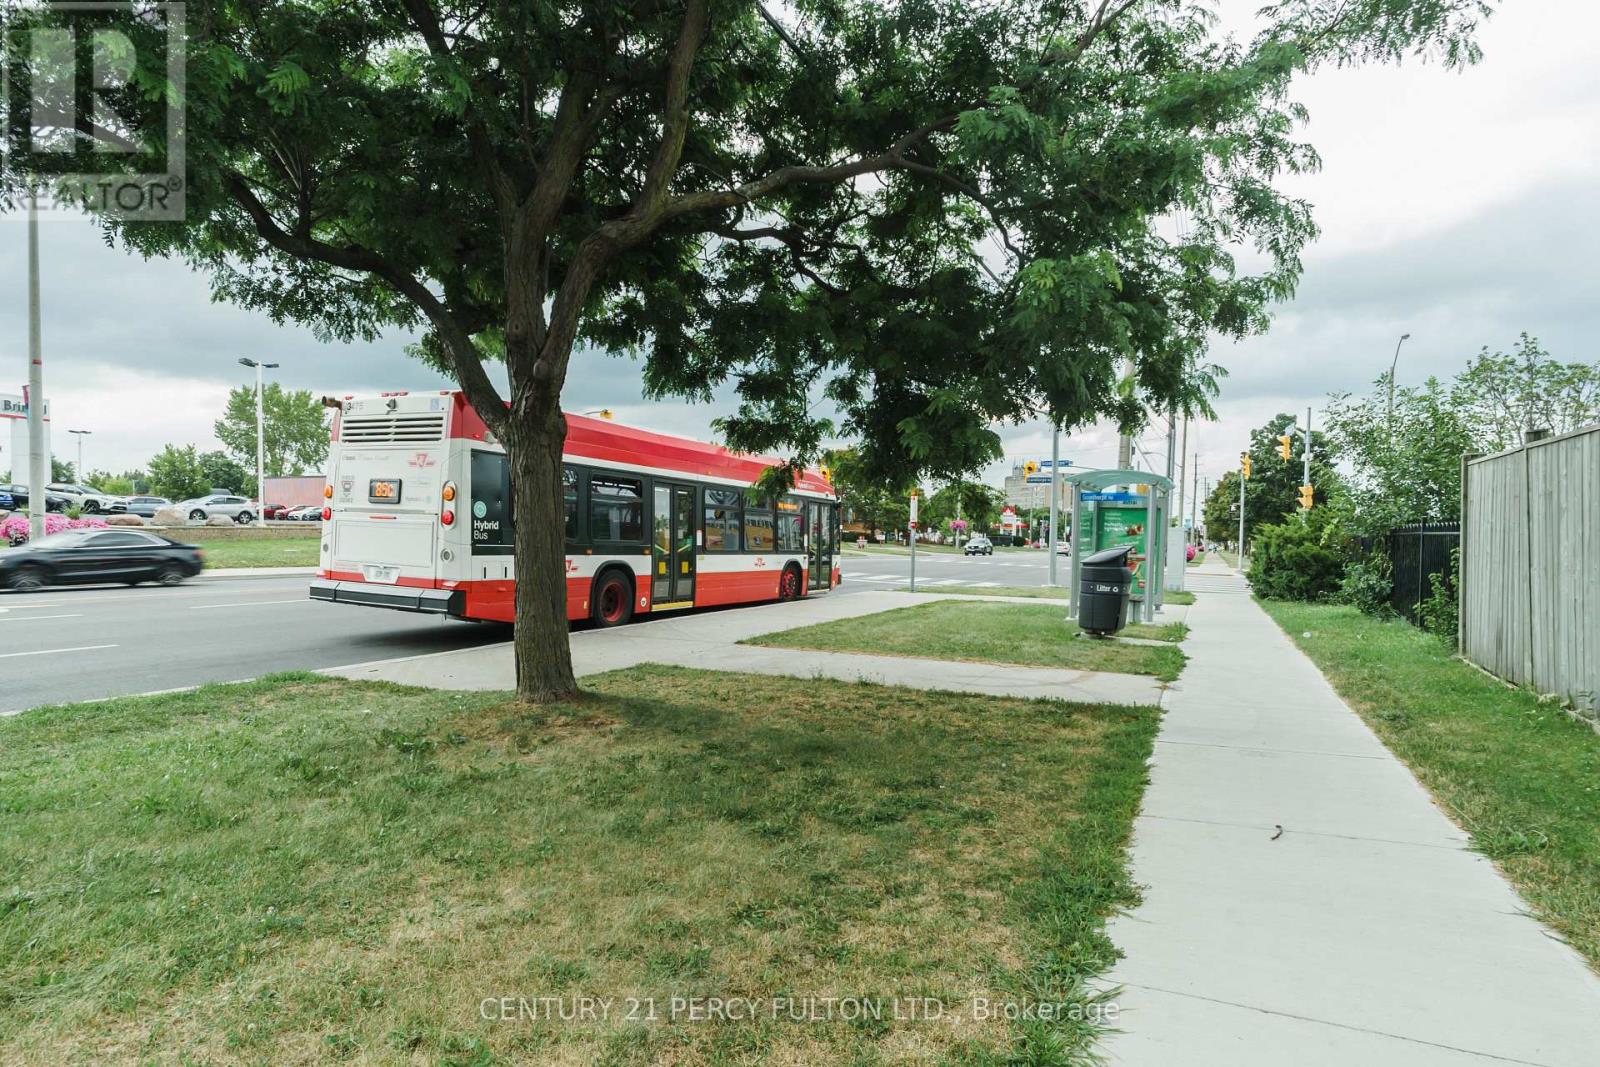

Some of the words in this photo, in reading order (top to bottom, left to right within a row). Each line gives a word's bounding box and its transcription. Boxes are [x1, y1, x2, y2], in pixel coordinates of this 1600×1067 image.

[474, 520, 499, 531] Hybrid
[473, 531, 488, 540] Bus
[1096, 584, 1111, 592] Litter
